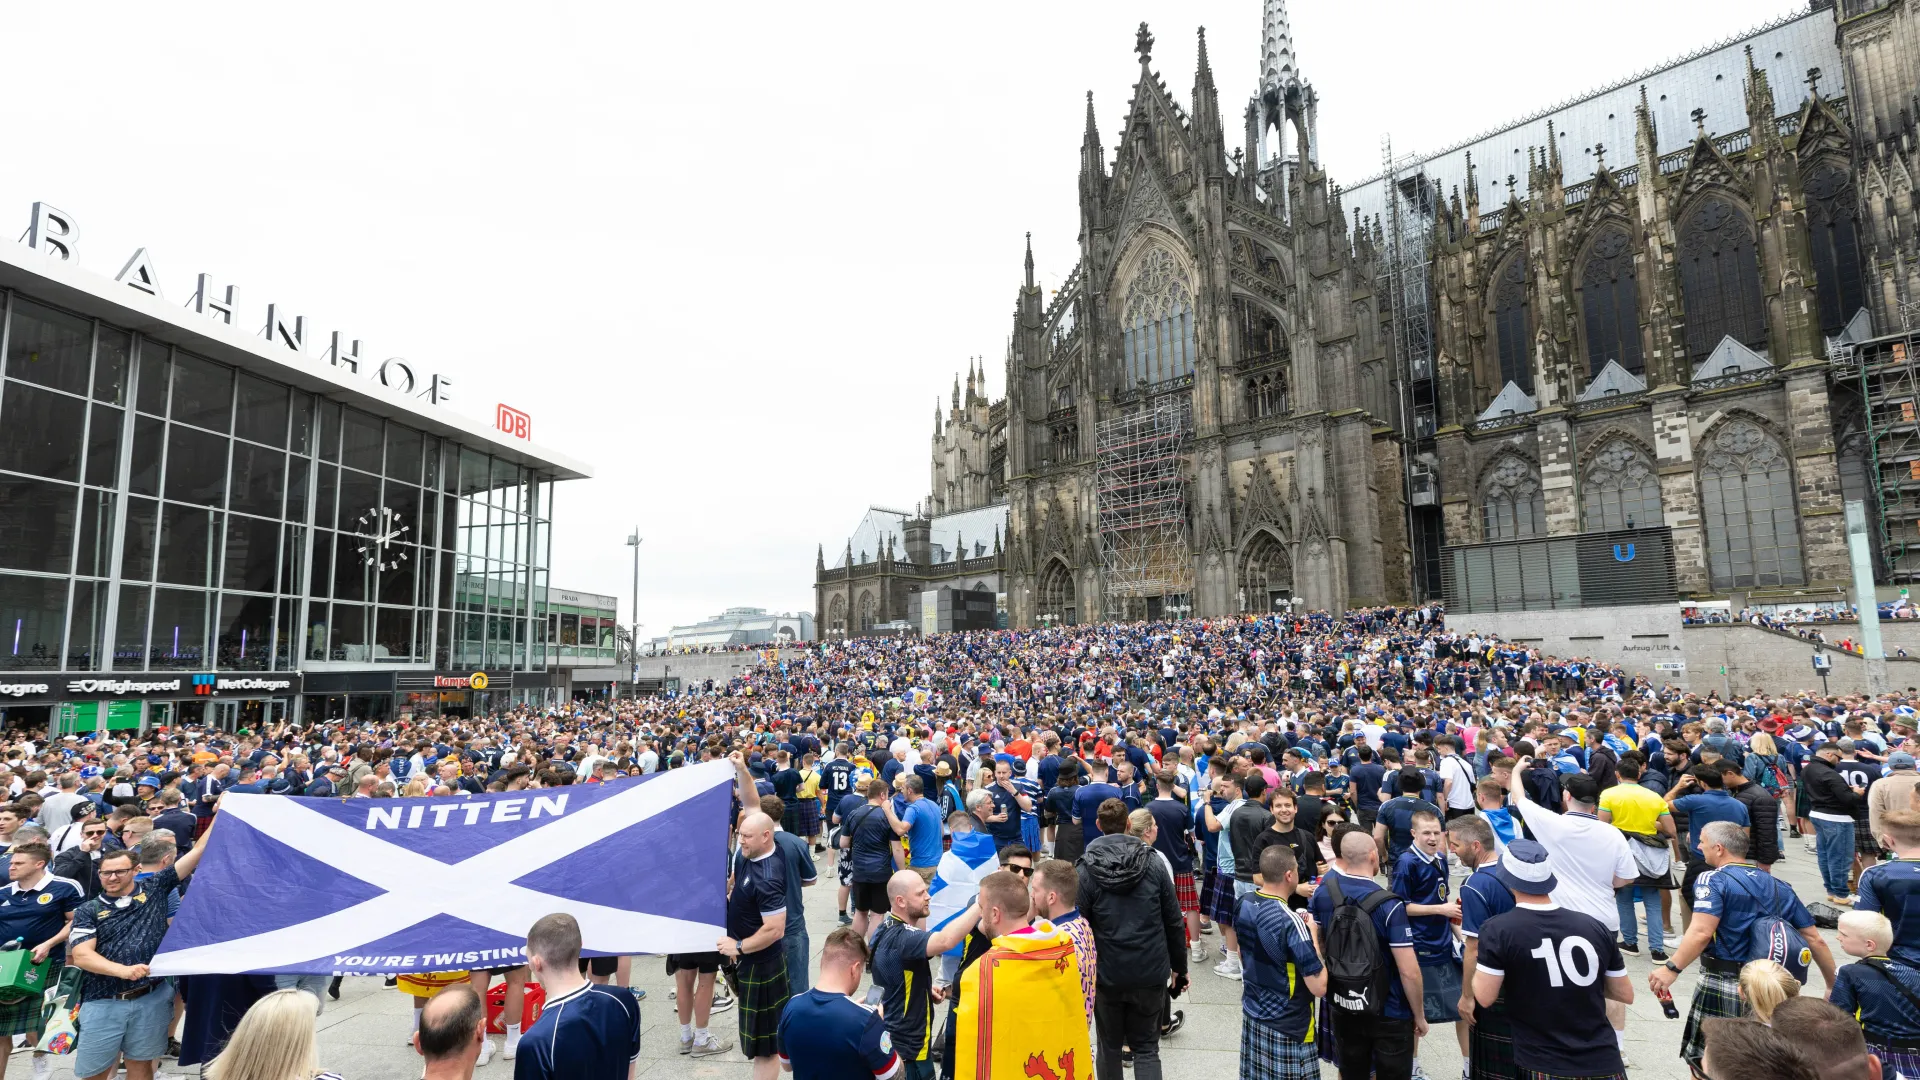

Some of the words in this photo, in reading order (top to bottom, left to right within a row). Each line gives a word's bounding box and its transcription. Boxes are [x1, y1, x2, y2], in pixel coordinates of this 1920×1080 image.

[29, 201, 453, 405] BAHNHOF
[501, 408, 527, 439] DB
[1613, 543, 1636, 562] U
[561, 594, 579, 602] PRADA
[96, 679, 181, 695] Highspeed
[217, 678, 291, 691] NetCologne
[434, 675, 471, 689] Kamps
[832, 771, 848, 790] 13
[366, 793, 570, 830] NITTEN
[1773, 932, 1784, 963] SCOTLA
[333, 955, 418, 967] YOU'RE
[1531, 935, 1600, 988] 10
[1333, 993, 1364, 1011] PUMA
